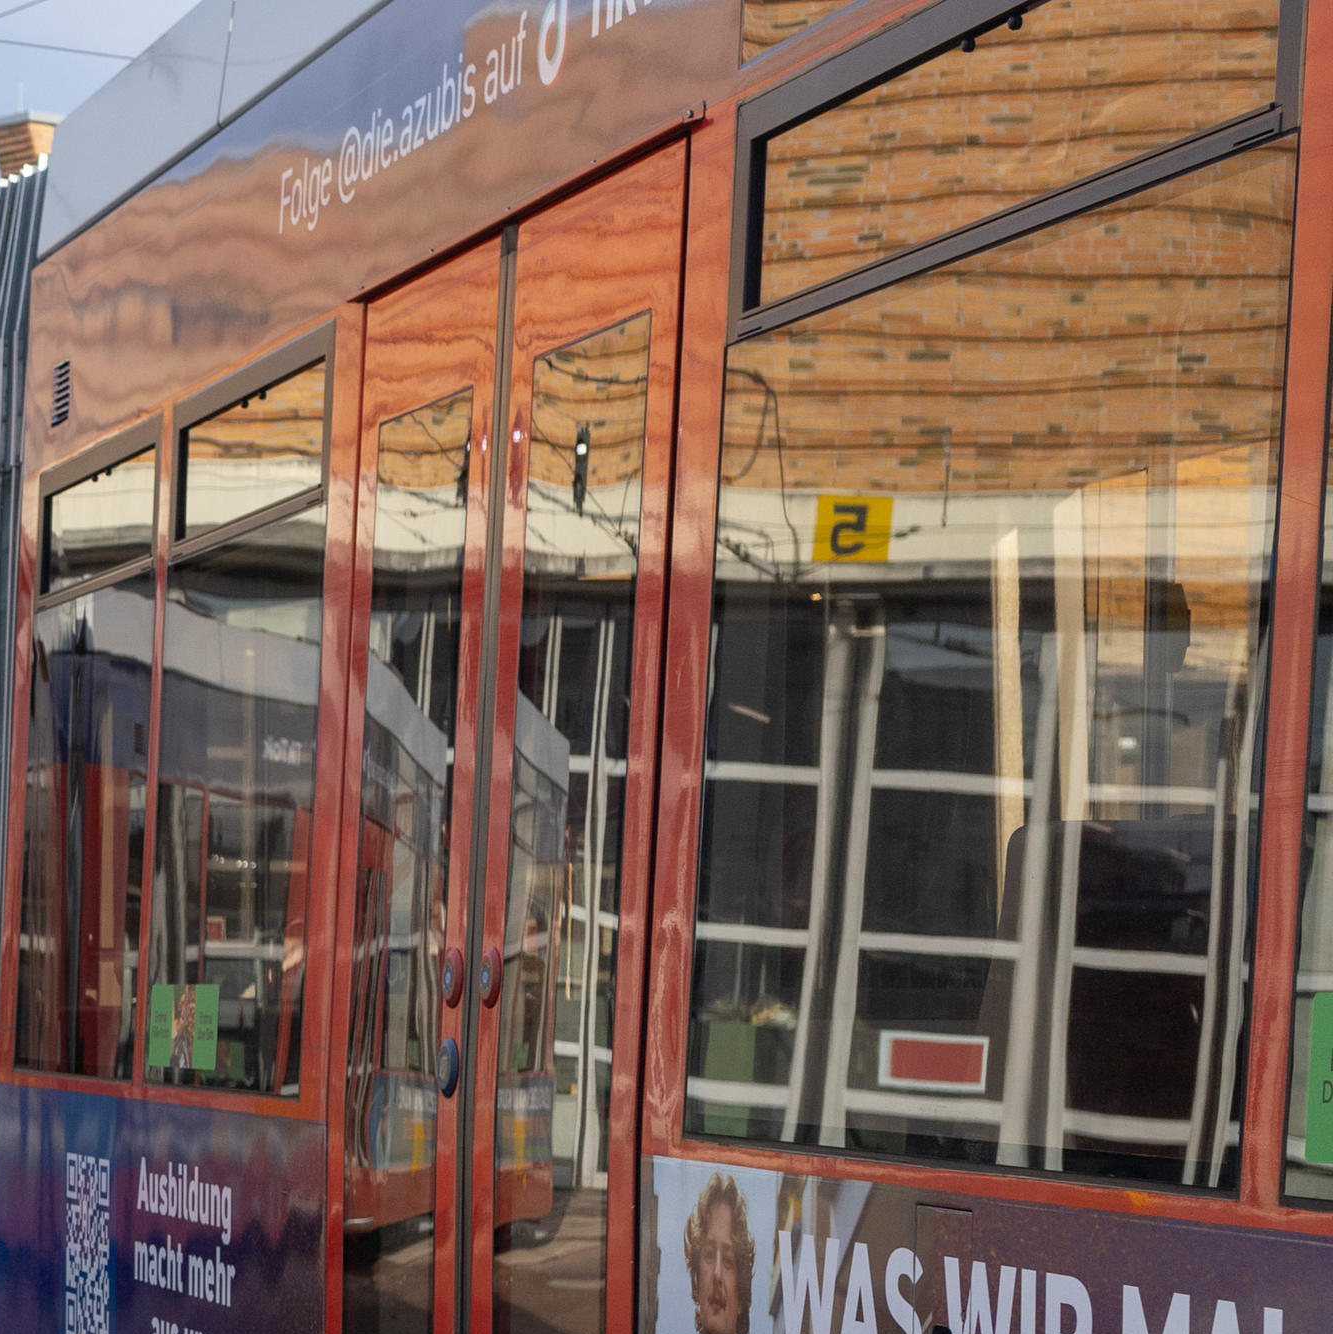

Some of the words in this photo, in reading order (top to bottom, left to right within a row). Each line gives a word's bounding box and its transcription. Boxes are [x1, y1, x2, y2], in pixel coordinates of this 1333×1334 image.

[278, 156, 333, 235] Folge
[337, 52, 476, 205] @die.azubis
[483, 10, 528, 105] auf
[136, 1156, 233, 1246] Ausbildung
[133, 1234, 184, 1294] macht
[188, 1246, 236, 1308] mehr
